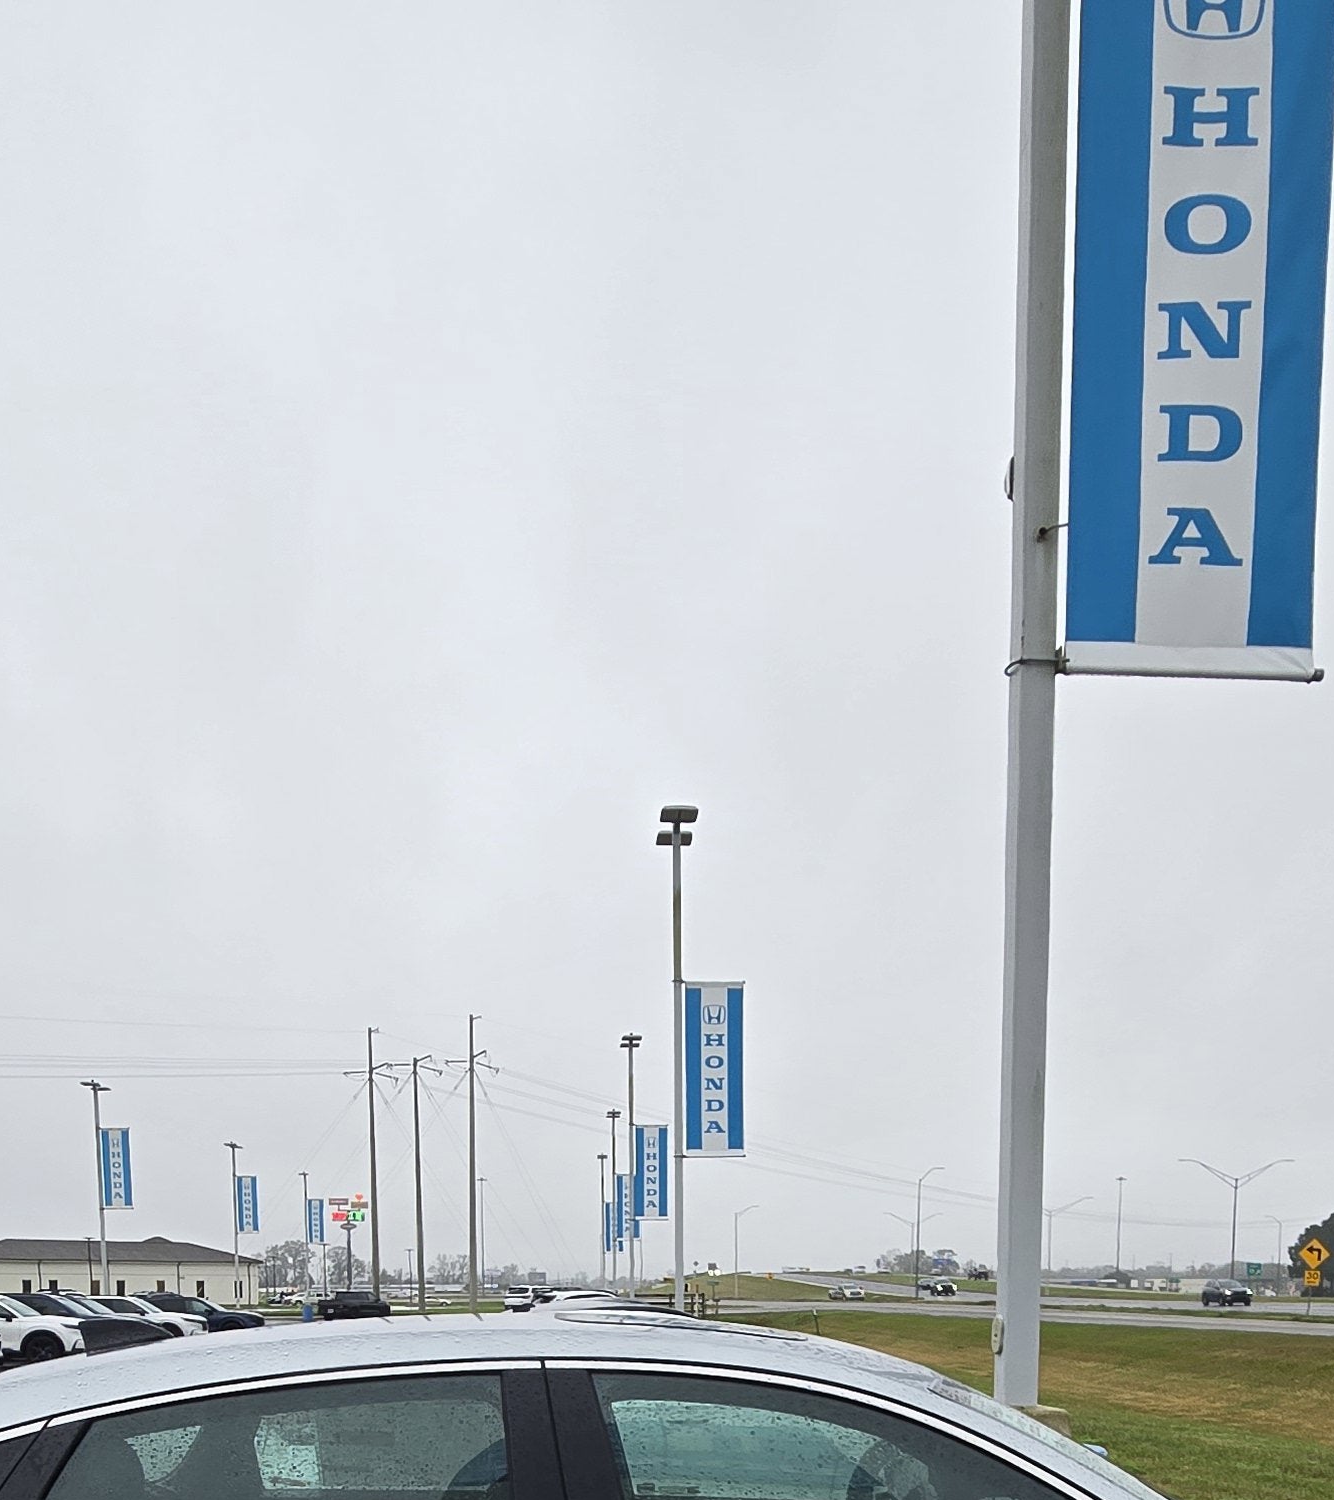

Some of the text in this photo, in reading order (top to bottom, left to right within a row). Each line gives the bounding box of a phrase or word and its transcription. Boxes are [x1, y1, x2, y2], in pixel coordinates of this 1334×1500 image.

[1148, 86, 1260, 566] HONDA
[703, 1033, 726, 1133] HONDA
[111, 1151, 123, 1199] HONDA
[646, 1153, 657, 1208] HONDA
[1307, 1272, 1318, 1280] 30
